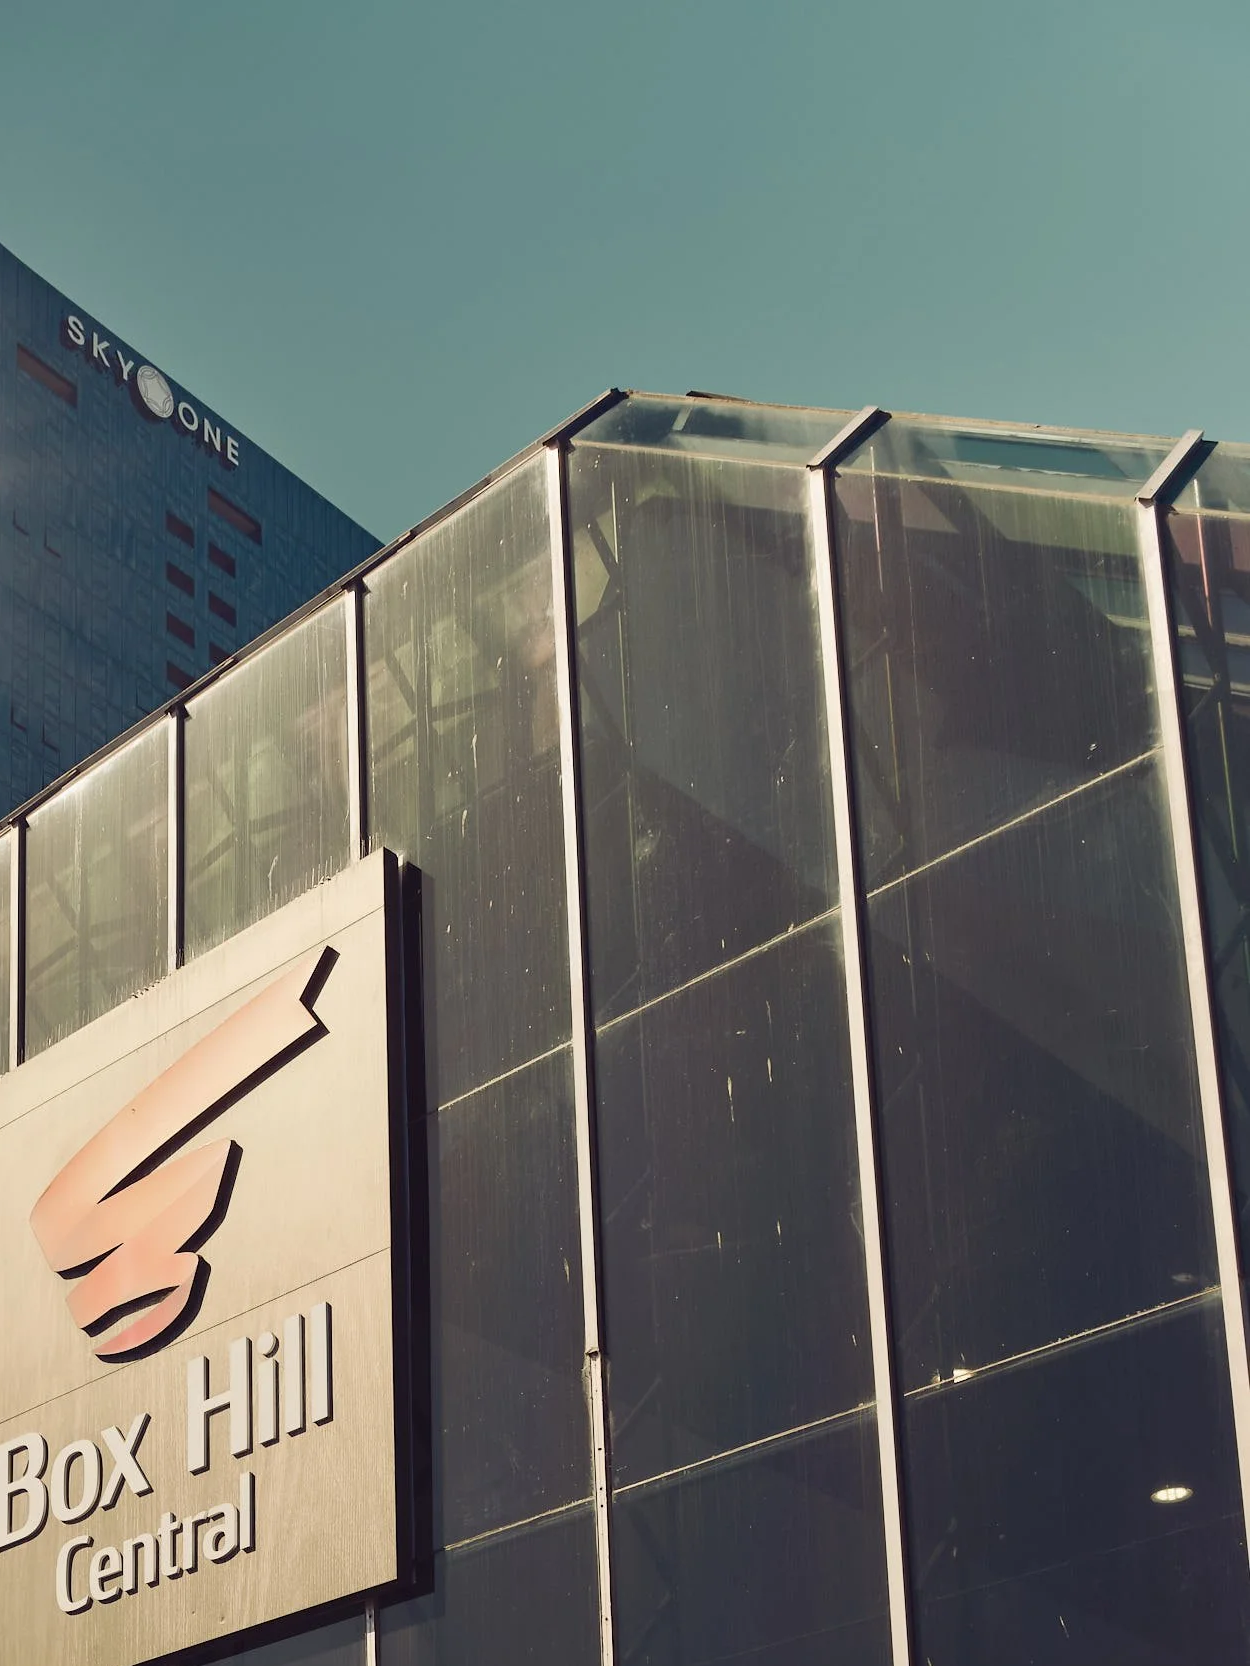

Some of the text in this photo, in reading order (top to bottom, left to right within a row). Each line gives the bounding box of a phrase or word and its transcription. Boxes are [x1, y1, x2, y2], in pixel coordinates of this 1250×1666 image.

[67, 315, 239, 466] SKY ONE
[187, 1301, 334, 1476] Hill
[55, 1471, 256, 1616] Central
